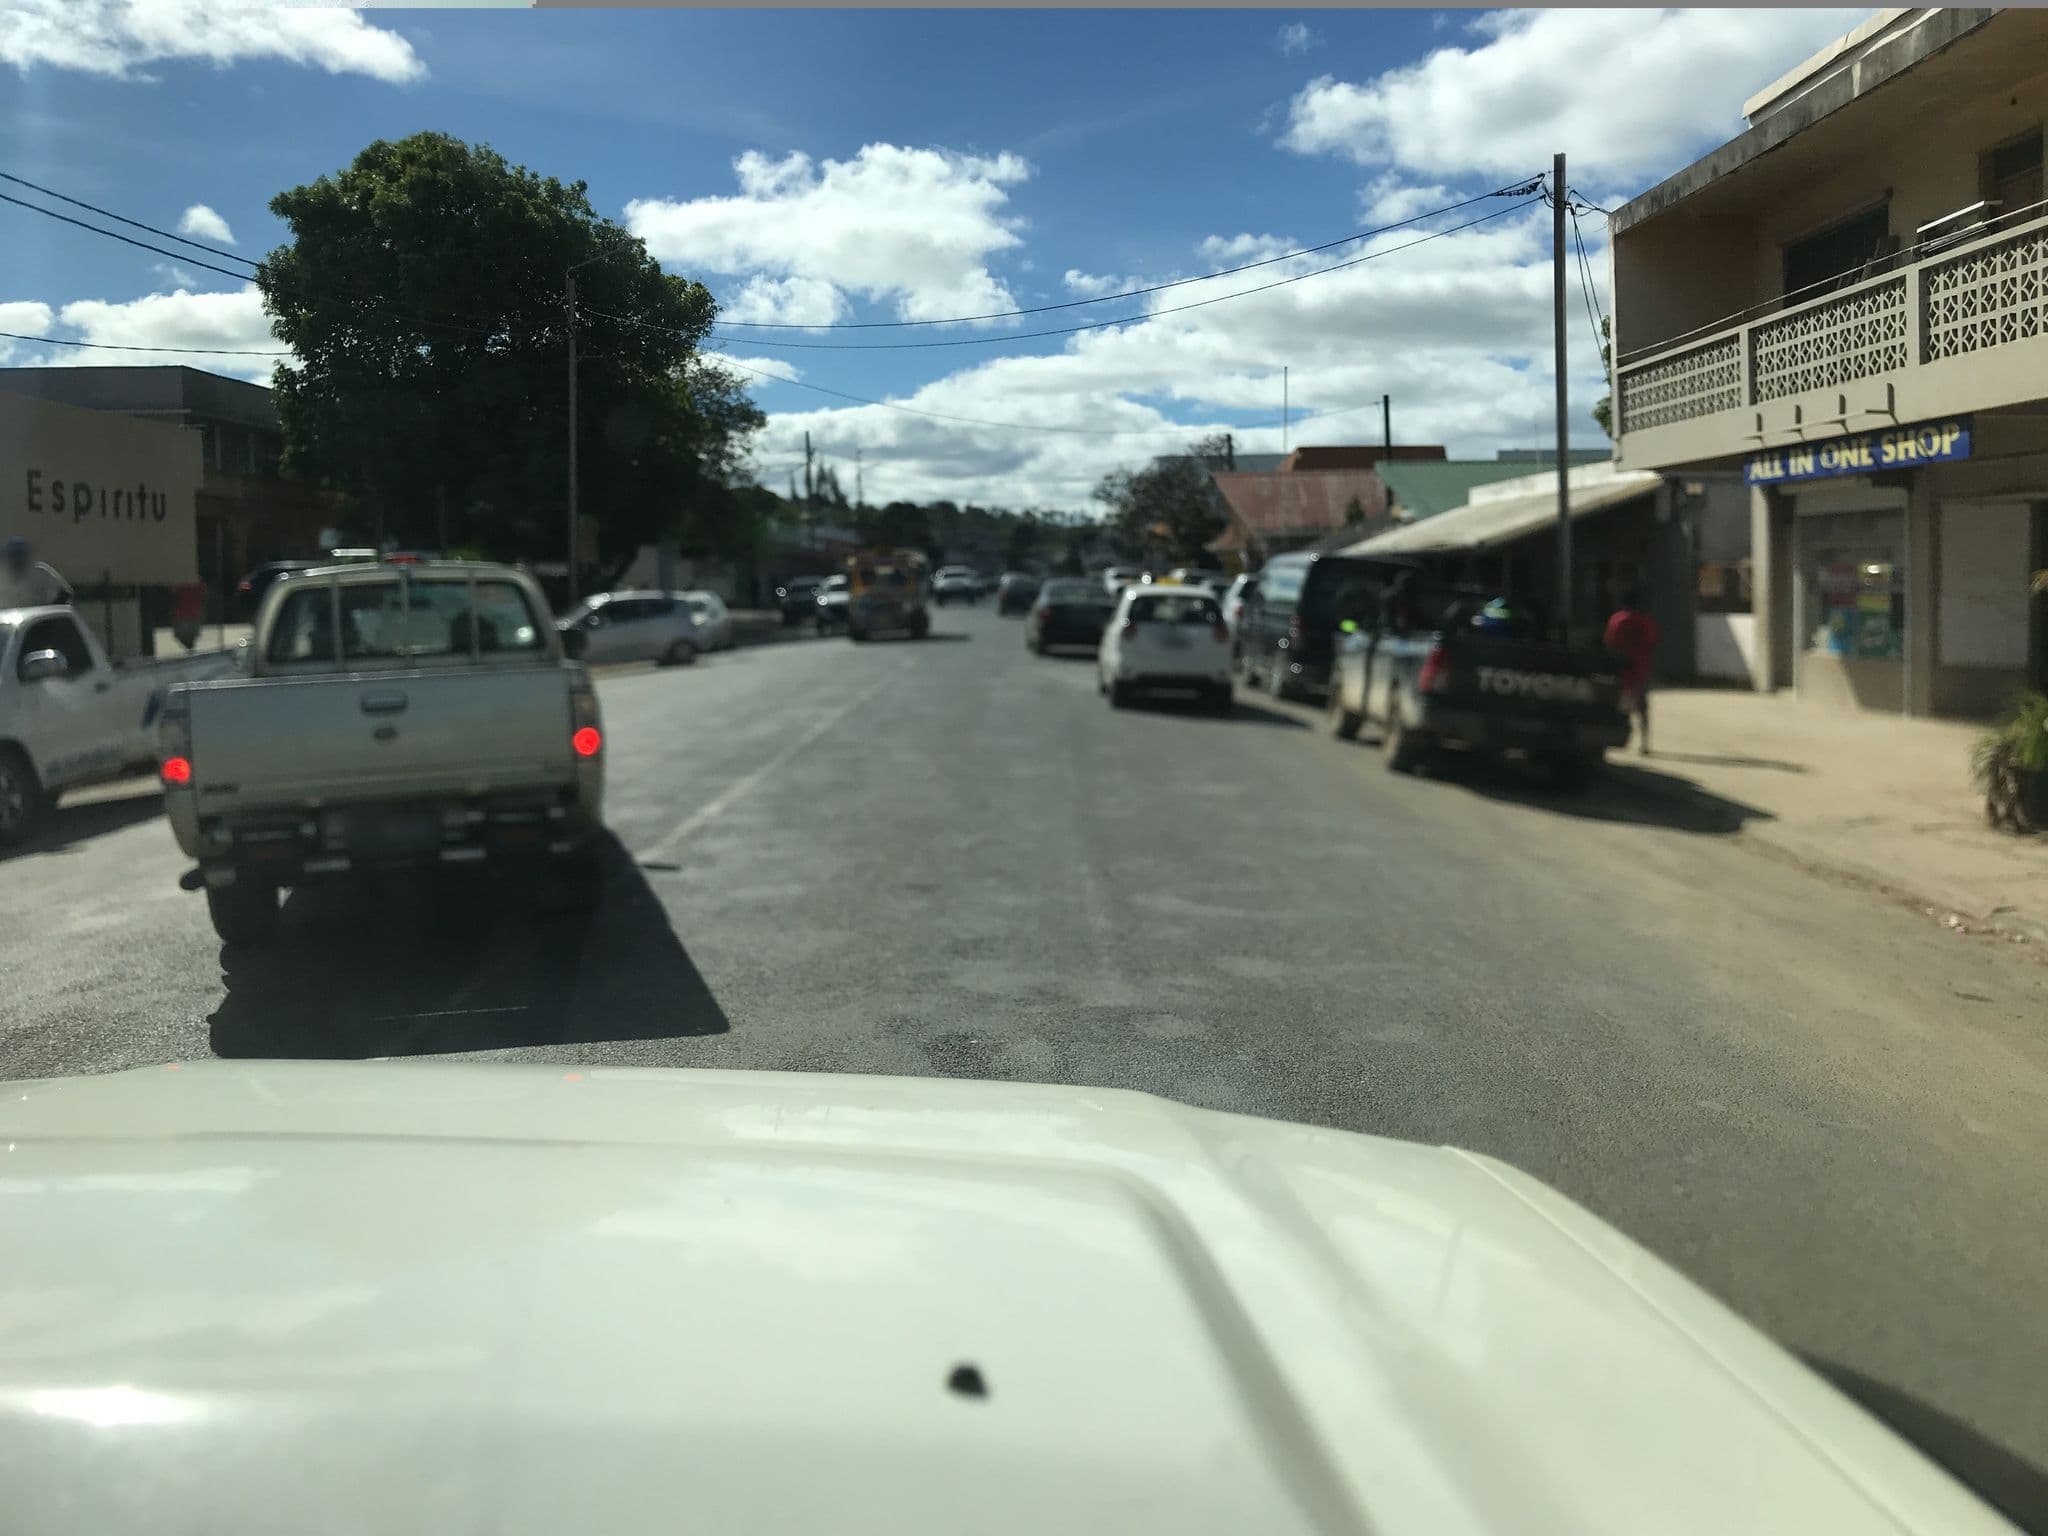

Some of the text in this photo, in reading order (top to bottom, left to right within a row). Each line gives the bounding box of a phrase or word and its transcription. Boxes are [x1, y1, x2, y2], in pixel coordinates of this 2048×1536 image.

[1749, 424, 1961, 480] ALL IN ONE SHOP
[27, 469, 167, 523] Espiritu
